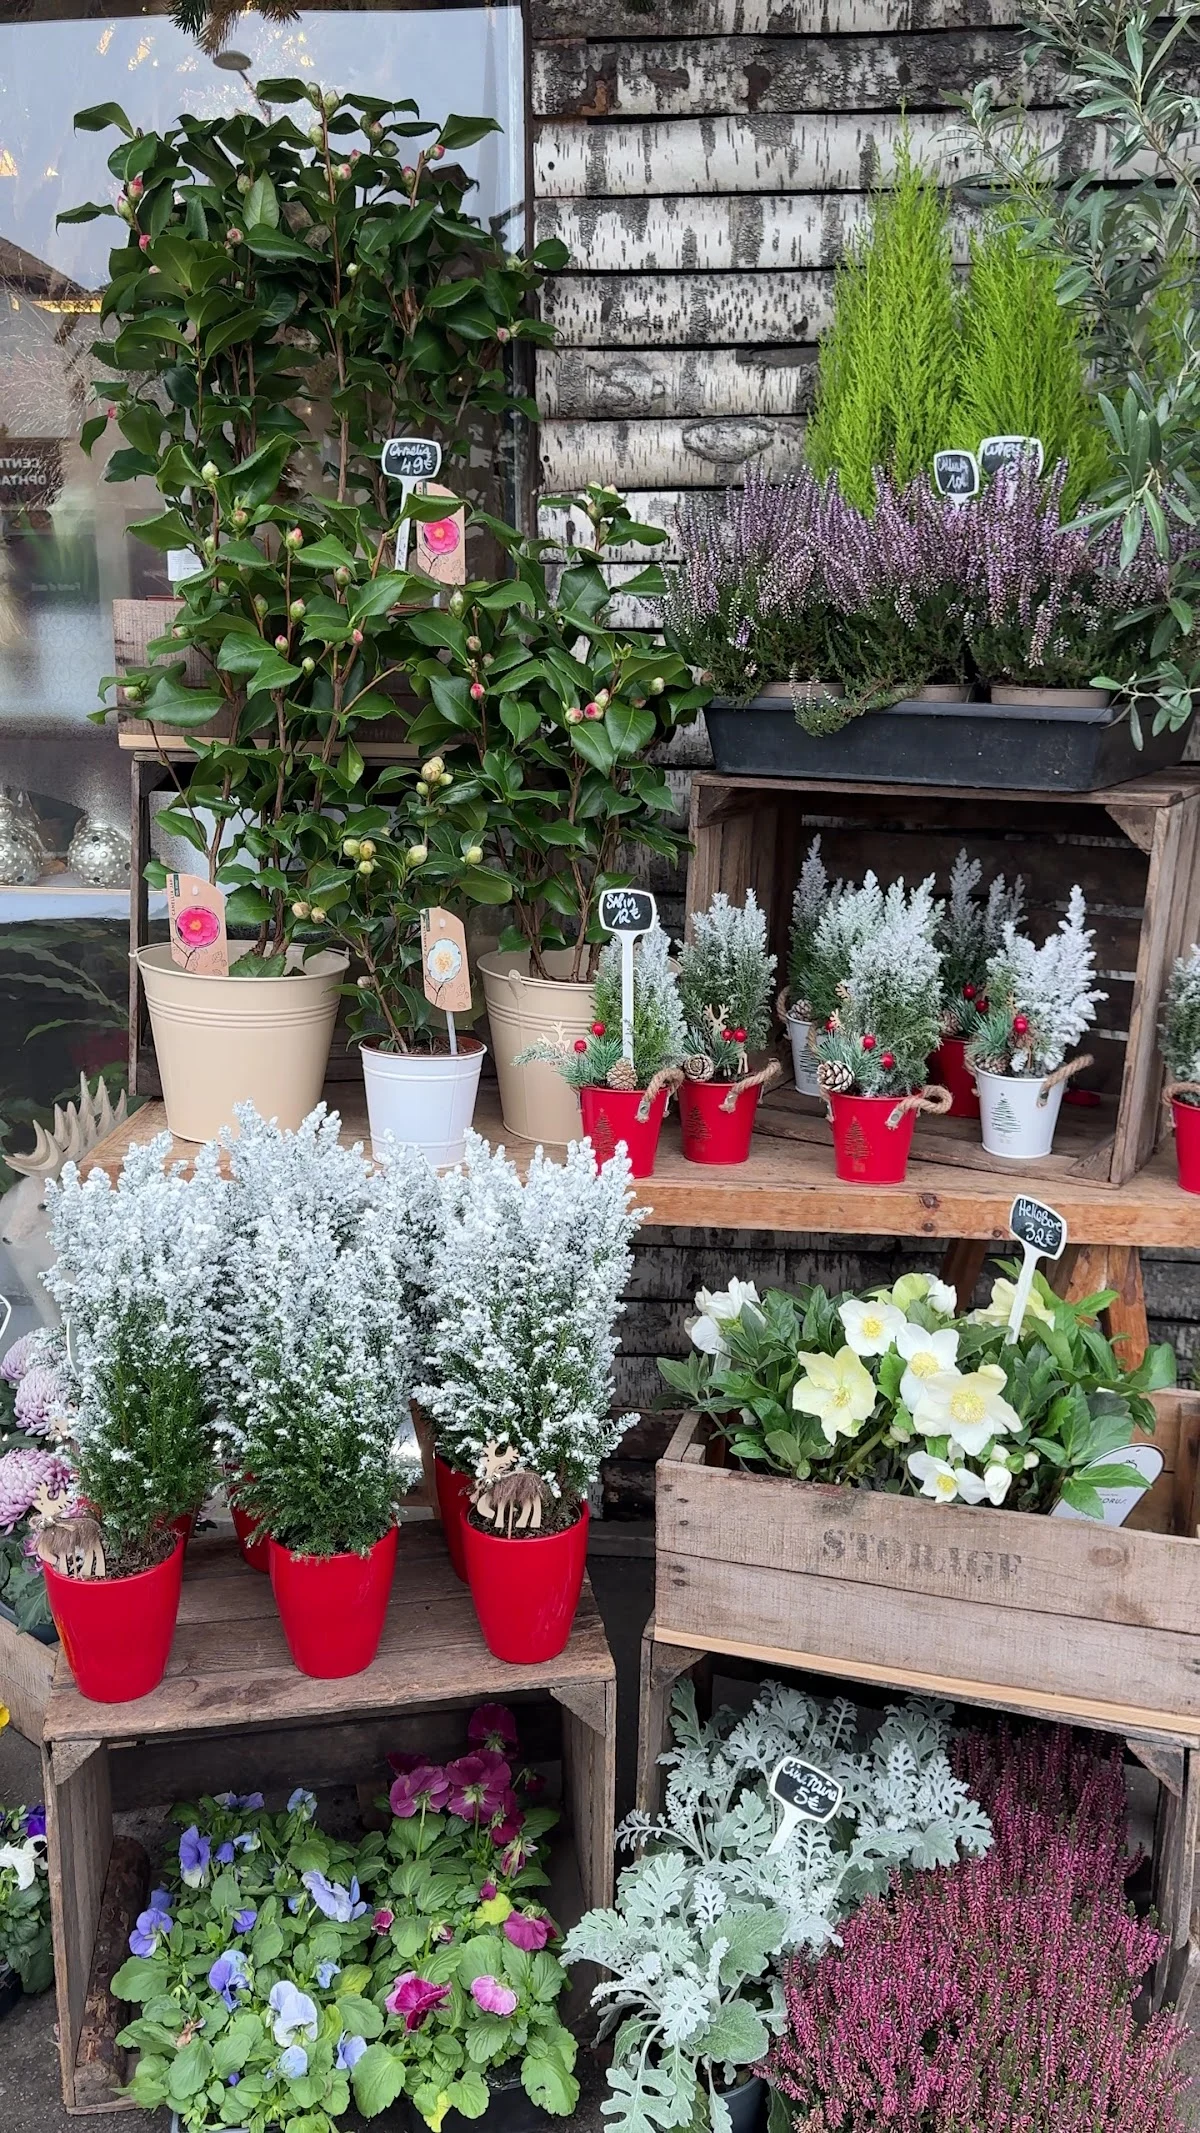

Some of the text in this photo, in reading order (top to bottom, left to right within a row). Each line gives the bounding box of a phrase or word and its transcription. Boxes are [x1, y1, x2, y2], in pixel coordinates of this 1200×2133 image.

[401, 457, 434, 474] 49€
[611, 907, 641, 926] 12€
[1024, 1221, 1059, 1247] 32€
[820, 1529, 1022, 1580] STORAGE
[793, 1786, 829, 1813] 5€
